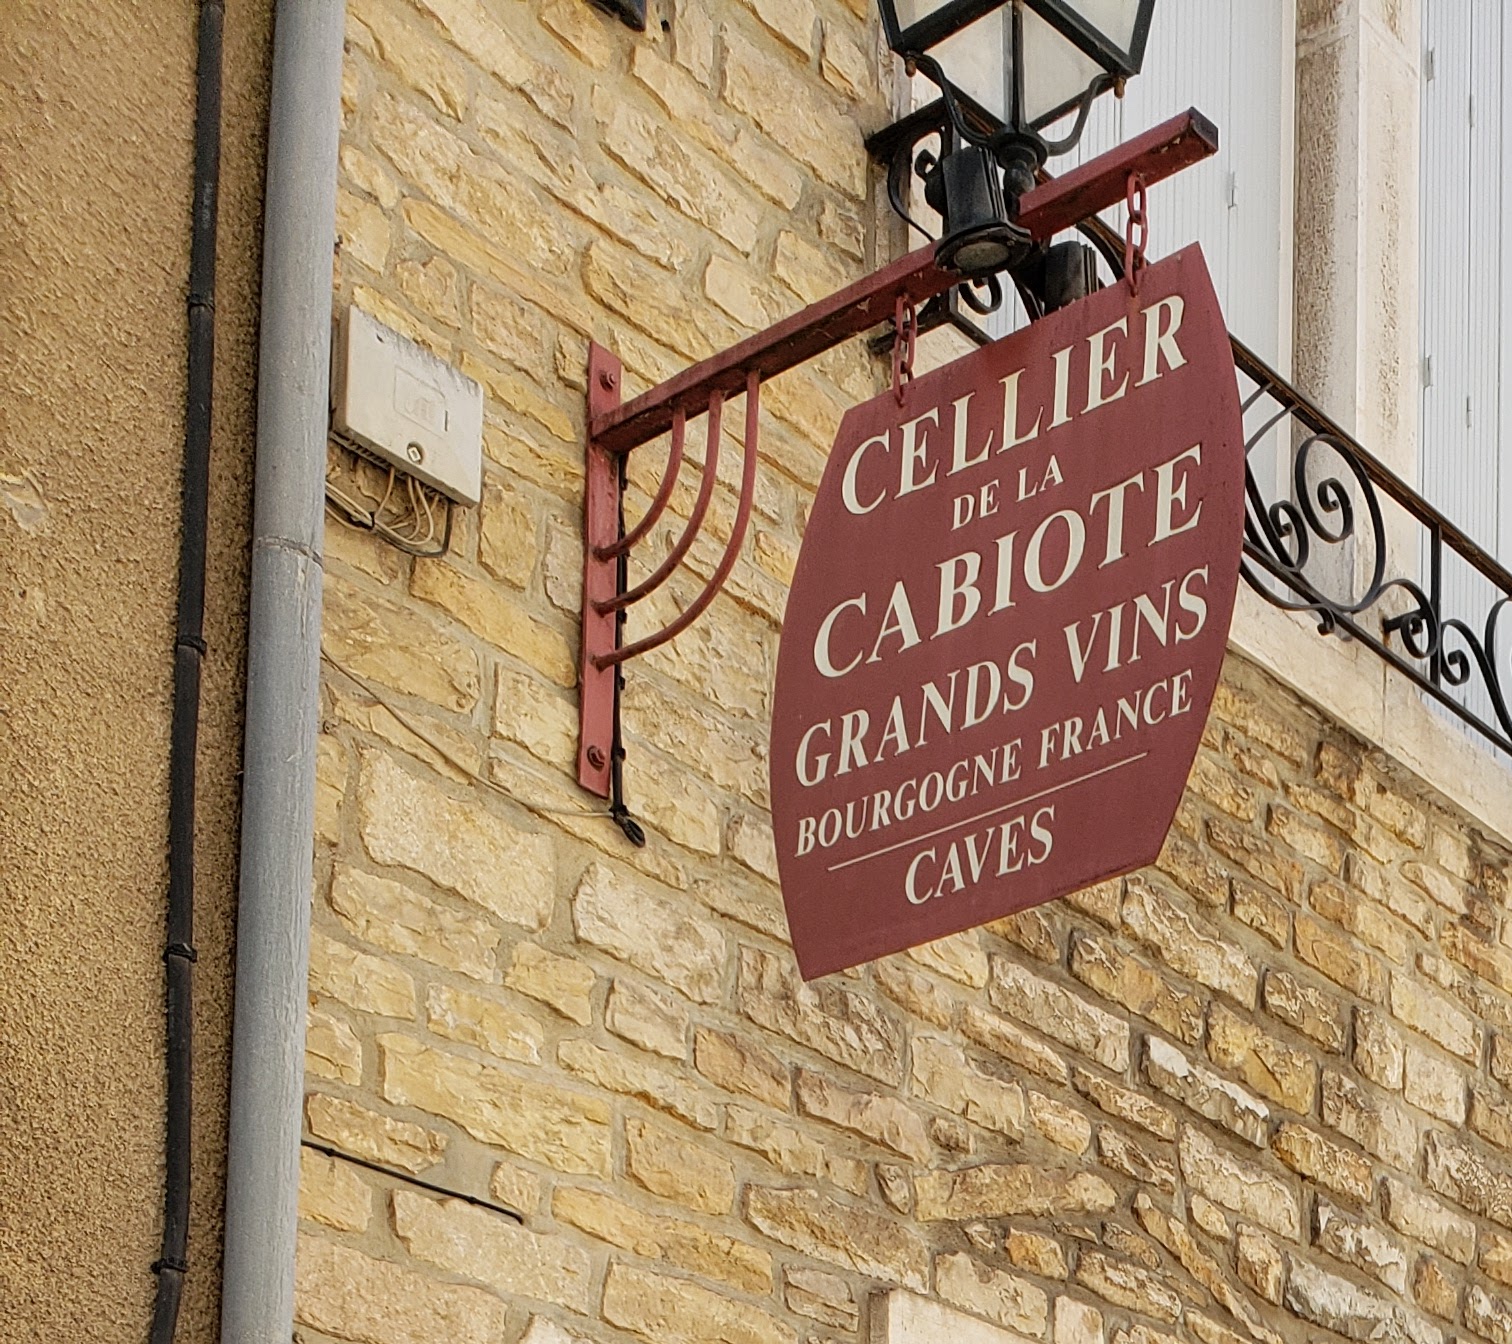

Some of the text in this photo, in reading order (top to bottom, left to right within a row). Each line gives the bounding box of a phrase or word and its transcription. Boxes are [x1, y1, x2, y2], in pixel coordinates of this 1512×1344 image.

[840, 294, 1188, 516] CELLIER
[950, 454, 1063, 531] DE LA
[813, 443, 1204, 678] CABIOTE
[795, 564, 1209, 788] GRANDS VINS
[795, 669, 1194, 858] BOURGOGNE FRANCE
[904, 805, 1056, 906] CAVES
